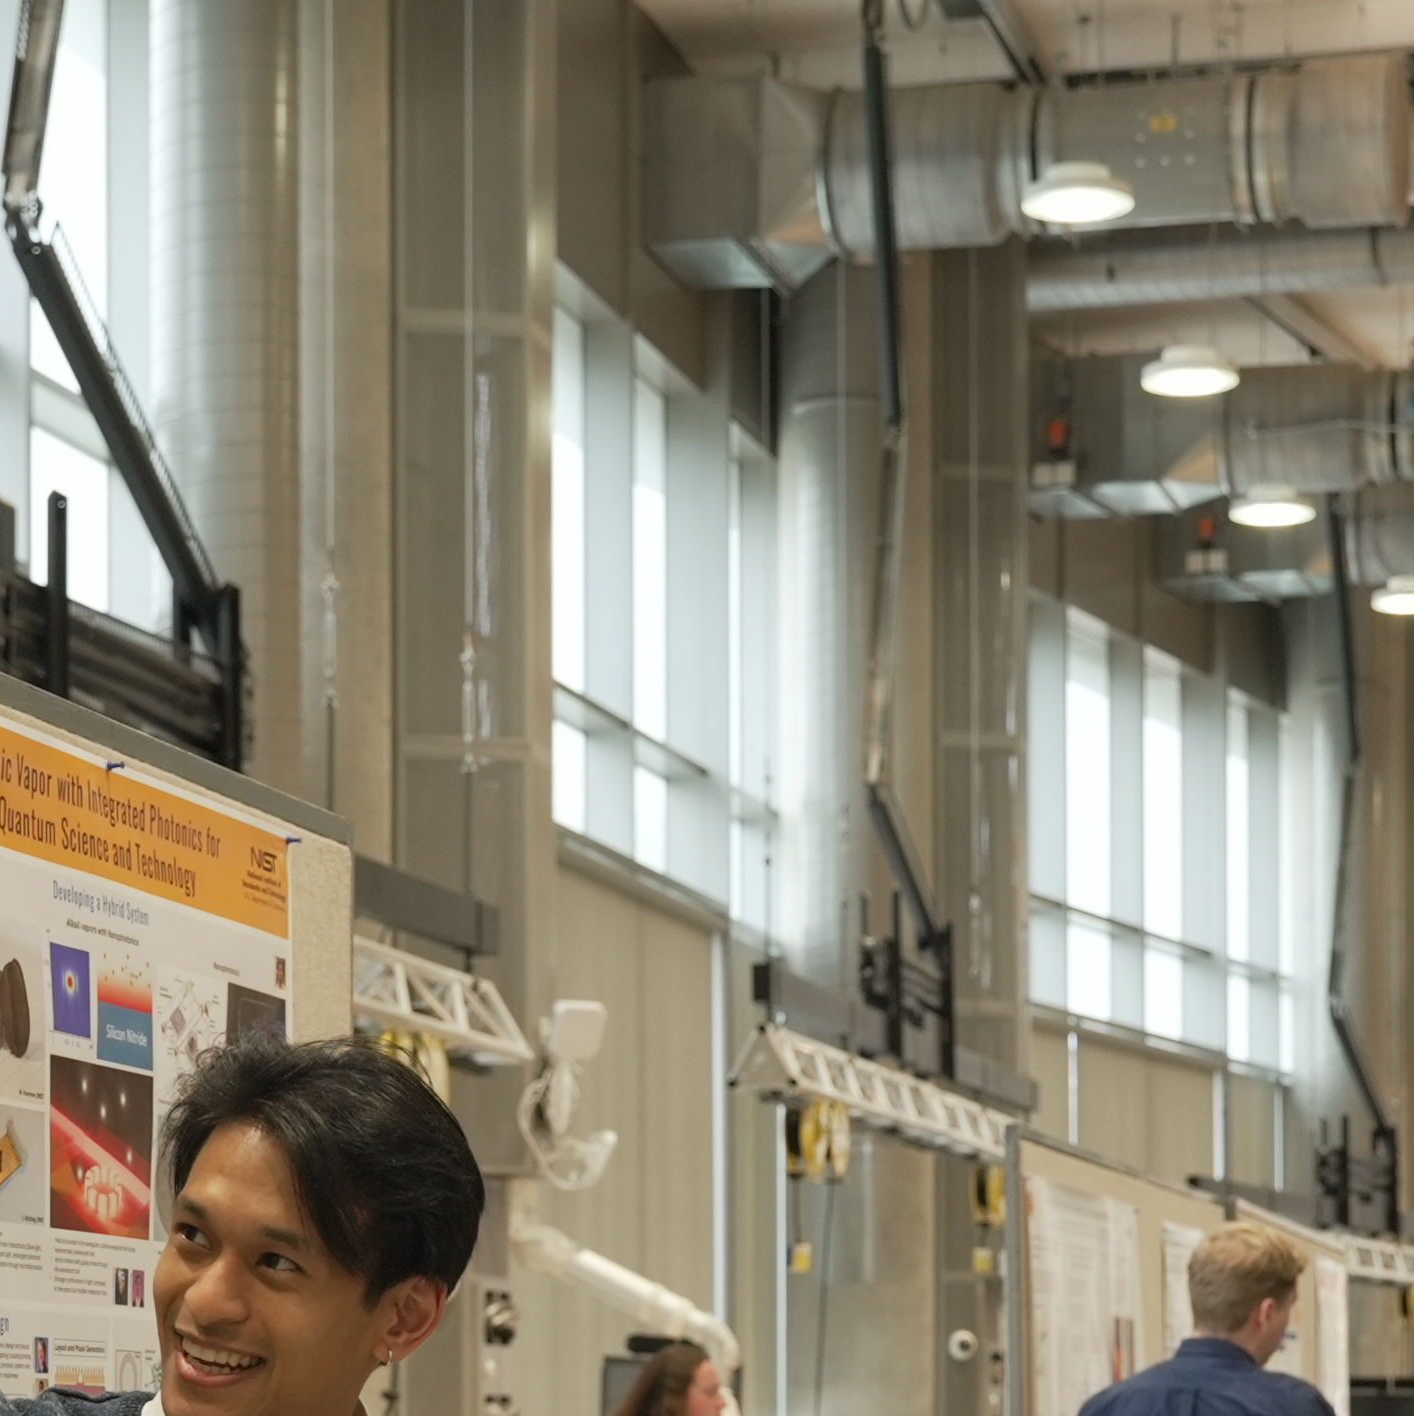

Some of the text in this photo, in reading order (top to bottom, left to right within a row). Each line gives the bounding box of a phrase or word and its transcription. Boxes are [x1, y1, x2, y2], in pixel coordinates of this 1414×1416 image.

[16, 753, 52, 800] Vapor
[57, 773, 83, 808] with
[87, 779, 145, 832] Integrated
[150, 803, 203, 853] Photonics
[206, 827, 221, 858] for
[61, 816, 109, 863] Science
[112, 840, 132, 871] and
[134, 842, 196, 898] Technology
[251, 846, 277, 873] NIST
[53, 880, 148, 925] Developing a Hybrid System
[106, 1024, 147, 1047] Silicon Nitride
